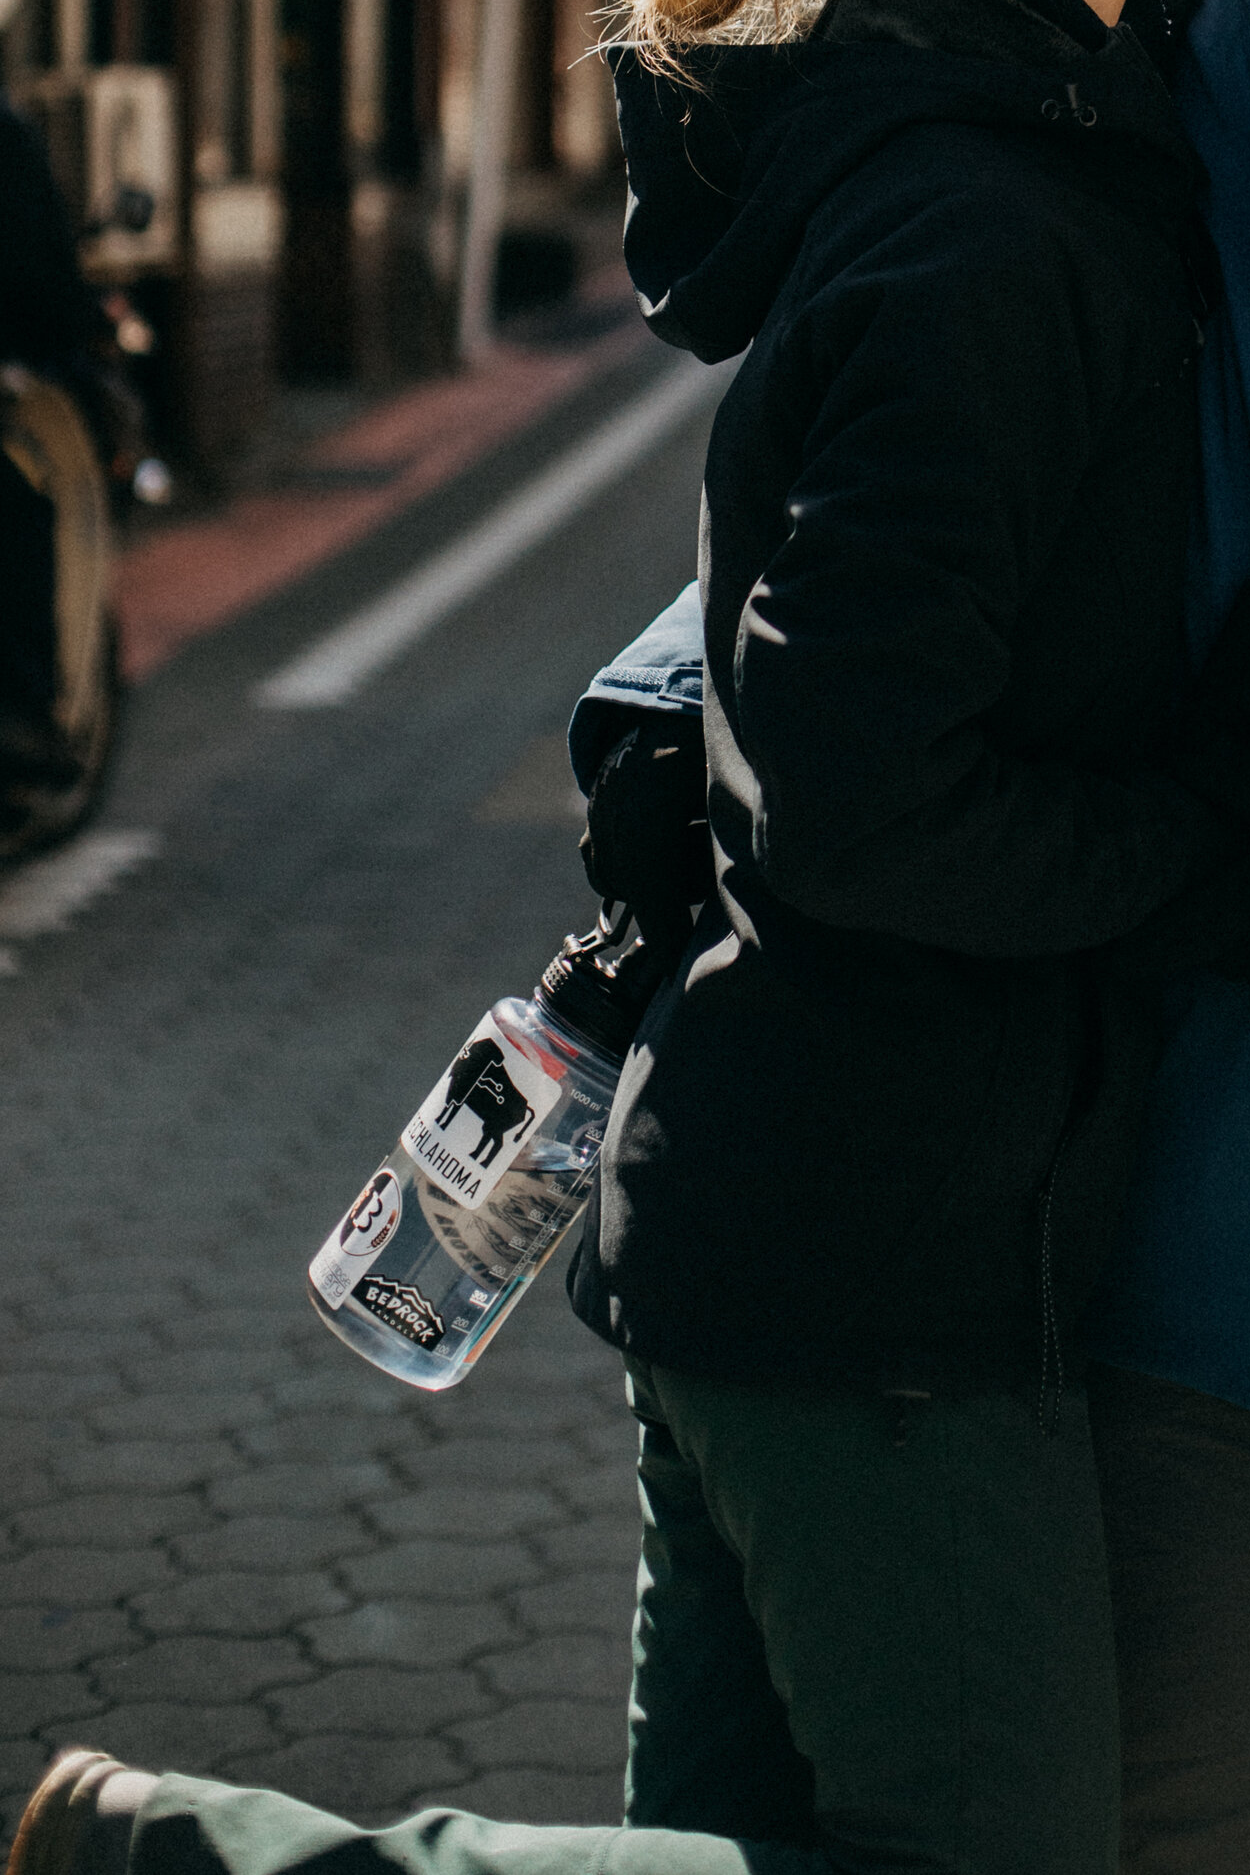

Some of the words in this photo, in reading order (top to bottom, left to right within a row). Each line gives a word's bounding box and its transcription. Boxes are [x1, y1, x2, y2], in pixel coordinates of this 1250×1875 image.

[570, 1088, 591, 1105] 1000
[590, 1102, 603, 1112] ml
[587, 1126, 603, 1139] 900
[491, 1264, 506, 1276] 400
[471, 1289, 488, 1302] 300
[365, 1286, 435, 1343] BEDROCK
[370, 1304, 415, 1339] SANDALS
[453, 1316, 469, 1328] 200
